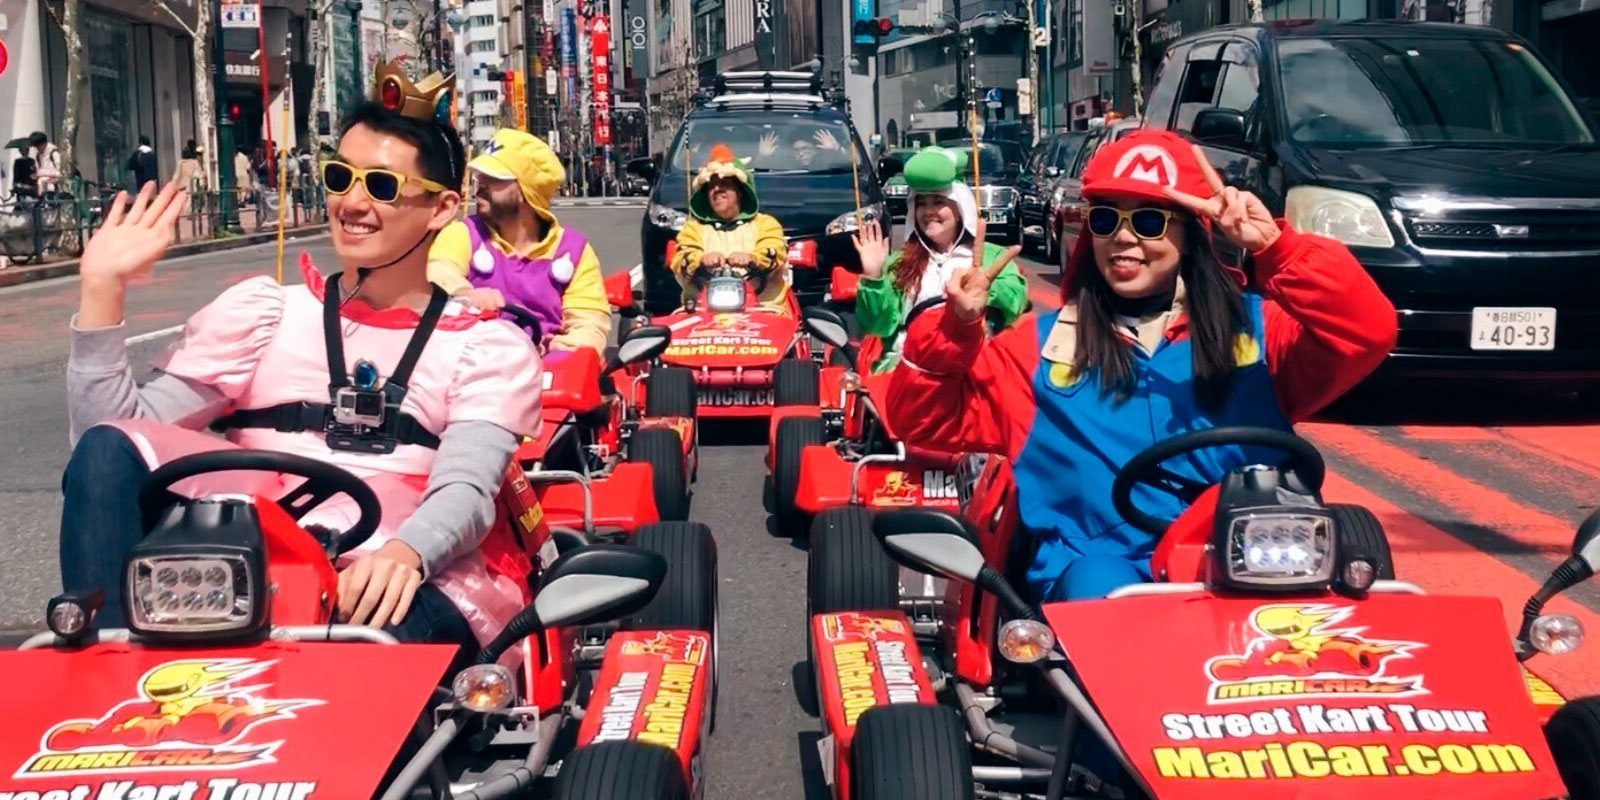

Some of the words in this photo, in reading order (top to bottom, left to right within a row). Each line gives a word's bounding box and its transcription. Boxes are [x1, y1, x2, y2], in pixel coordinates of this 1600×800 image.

[756, 0, 772, 33] RA
[1490, 325, 1550, 346] 40-93
[664, 344, 778, 356] MariCar.com
[697, 387, 775, 406] ariCar.co
[1162, 708, 1298, 741] Street
[1296, 704, 1393, 733] Kart
[1388, 703, 1489, 733] Tour
[1152, 740, 1536, 779] MariCar.com
